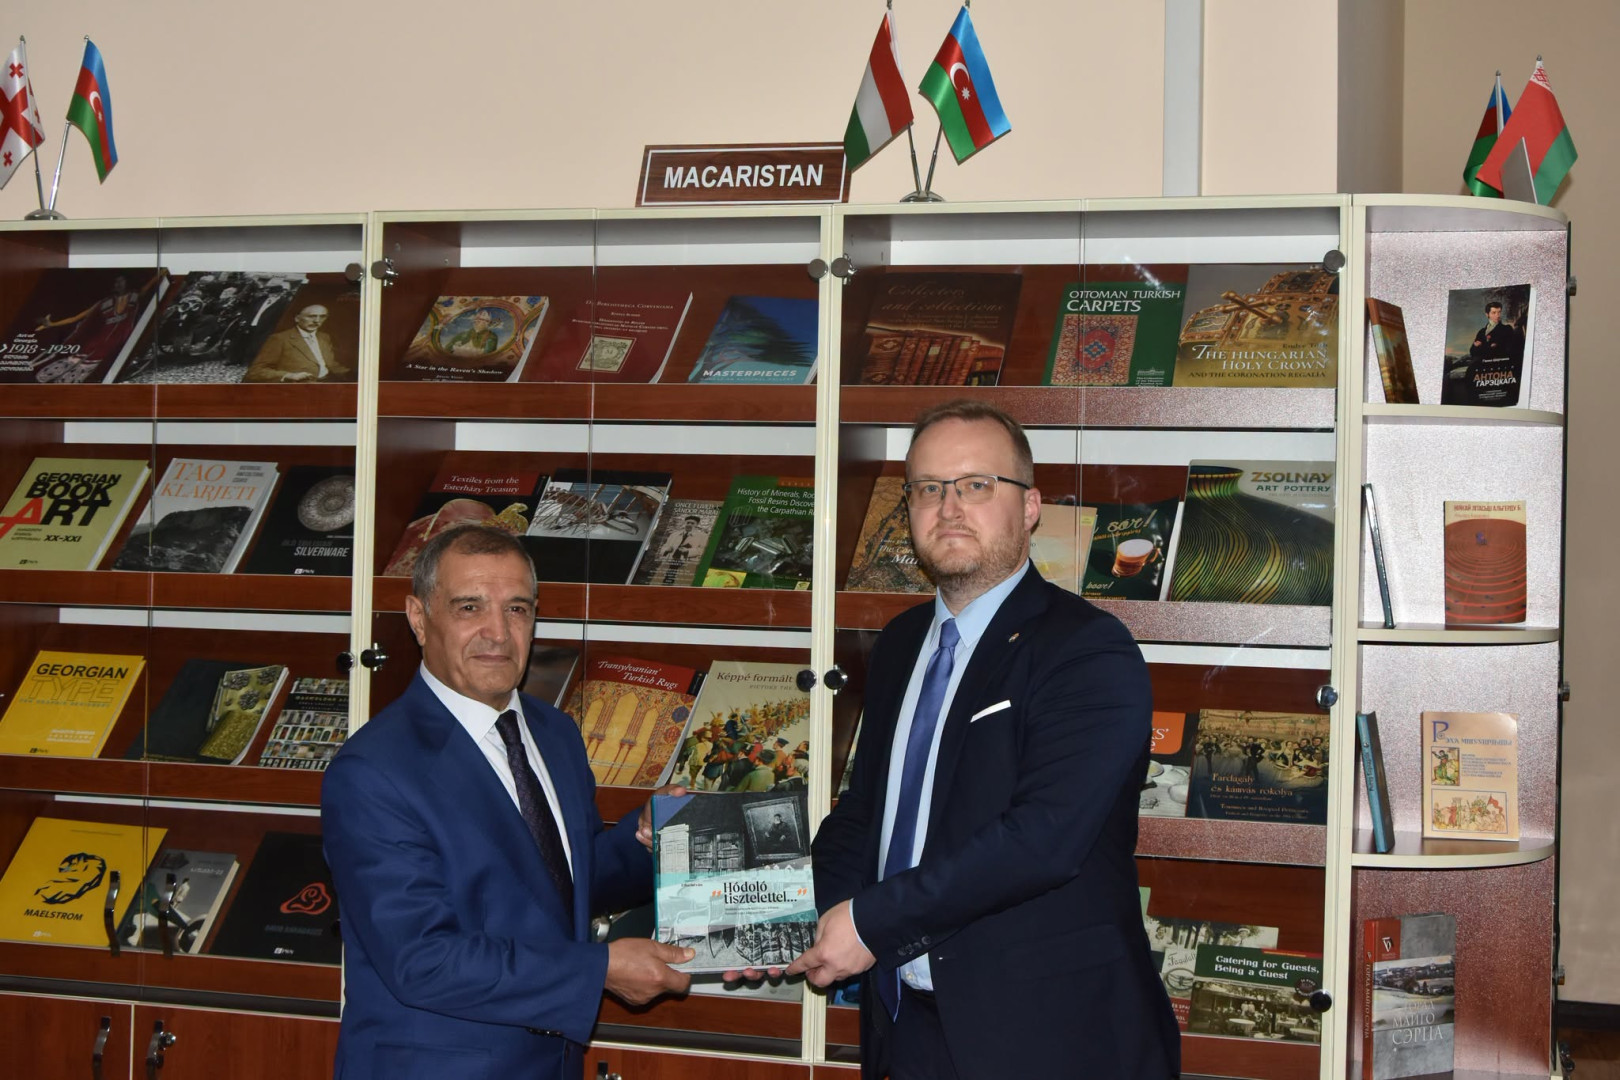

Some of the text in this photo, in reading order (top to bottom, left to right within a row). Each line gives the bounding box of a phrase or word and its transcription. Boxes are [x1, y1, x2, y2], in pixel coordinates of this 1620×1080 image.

[663, 164, 823, 188] MACARISTAN
[1069, 290, 1181, 299] OTTOMAN TURKISH
[1067, 299, 1142, 312] CARPETS
[8, 344, 38, 354] 1918
[1192, 344, 1327, 360] THE HUNGARIAN
[1222, 360, 1326, 371] HOLY CROWN
[1473, 371, 1513, 381] АНТОНА
[1476, 377, 1517, 387] ГАРЭЦКАГА
[35, 472, 122, 484] GEORGIAN
[174, 463, 226, 481] TAO
[1251, 472, 1334, 483] ZSOLNAY
[451, 475, 482, 484] Textiles
[25, 481, 117, 500] BOOK
[161, 484, 258, 501] KLARJETI
[485, 486, 519, 494] Treasury
[737, 488, 761, 497] History
[768, 498, 788, 506] Resins
[757, 505, 769, 513] the
[770, 507, 807, 515] Carpathian
[43, 534, 82, 543] XX-XXI
[294, 546, 350, 557] SILVERWARE
[36, 664, 128, 679] GEORGIAN
[717, 672, 793, 683] Képpé formált
[622, 672, 679, 690] Turkish Rugs
[29, 675, 120, 703] TYPE
[723, 880, 768, 893] Hódoló
[724, 892, 797, 904] tisztelettel...
[24, 908, 83, 921] MAELSTROM
[1215, 956, 1319, 974] Catering for Guests,
[1214, 965, 1244, 976] Being
[1258, 969, 1288, 980] Guest
[1392, 1025, 1443, 1045] СЭРЦА
